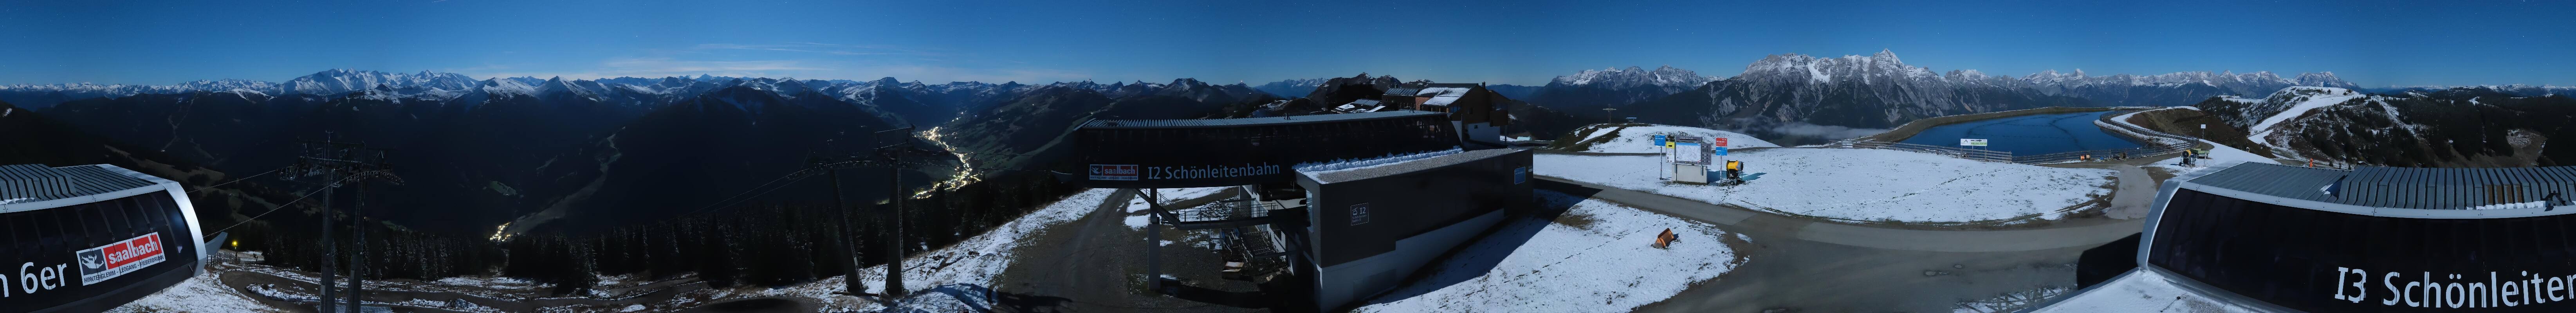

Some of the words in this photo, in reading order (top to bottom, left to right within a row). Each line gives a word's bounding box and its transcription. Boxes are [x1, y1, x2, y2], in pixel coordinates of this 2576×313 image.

[1104, 165, 1135, 174] saalbach
[1148, 167, 1161, 179] I2
[1165, 162, 1280, 179] Schönleitenbahn
[108, 236, 158, 264] saalbach
[21, 262, 67, 294] 6er
[120, 264, 137, 273] LEOGANG
[2334, 266, 2367, 303] I3
